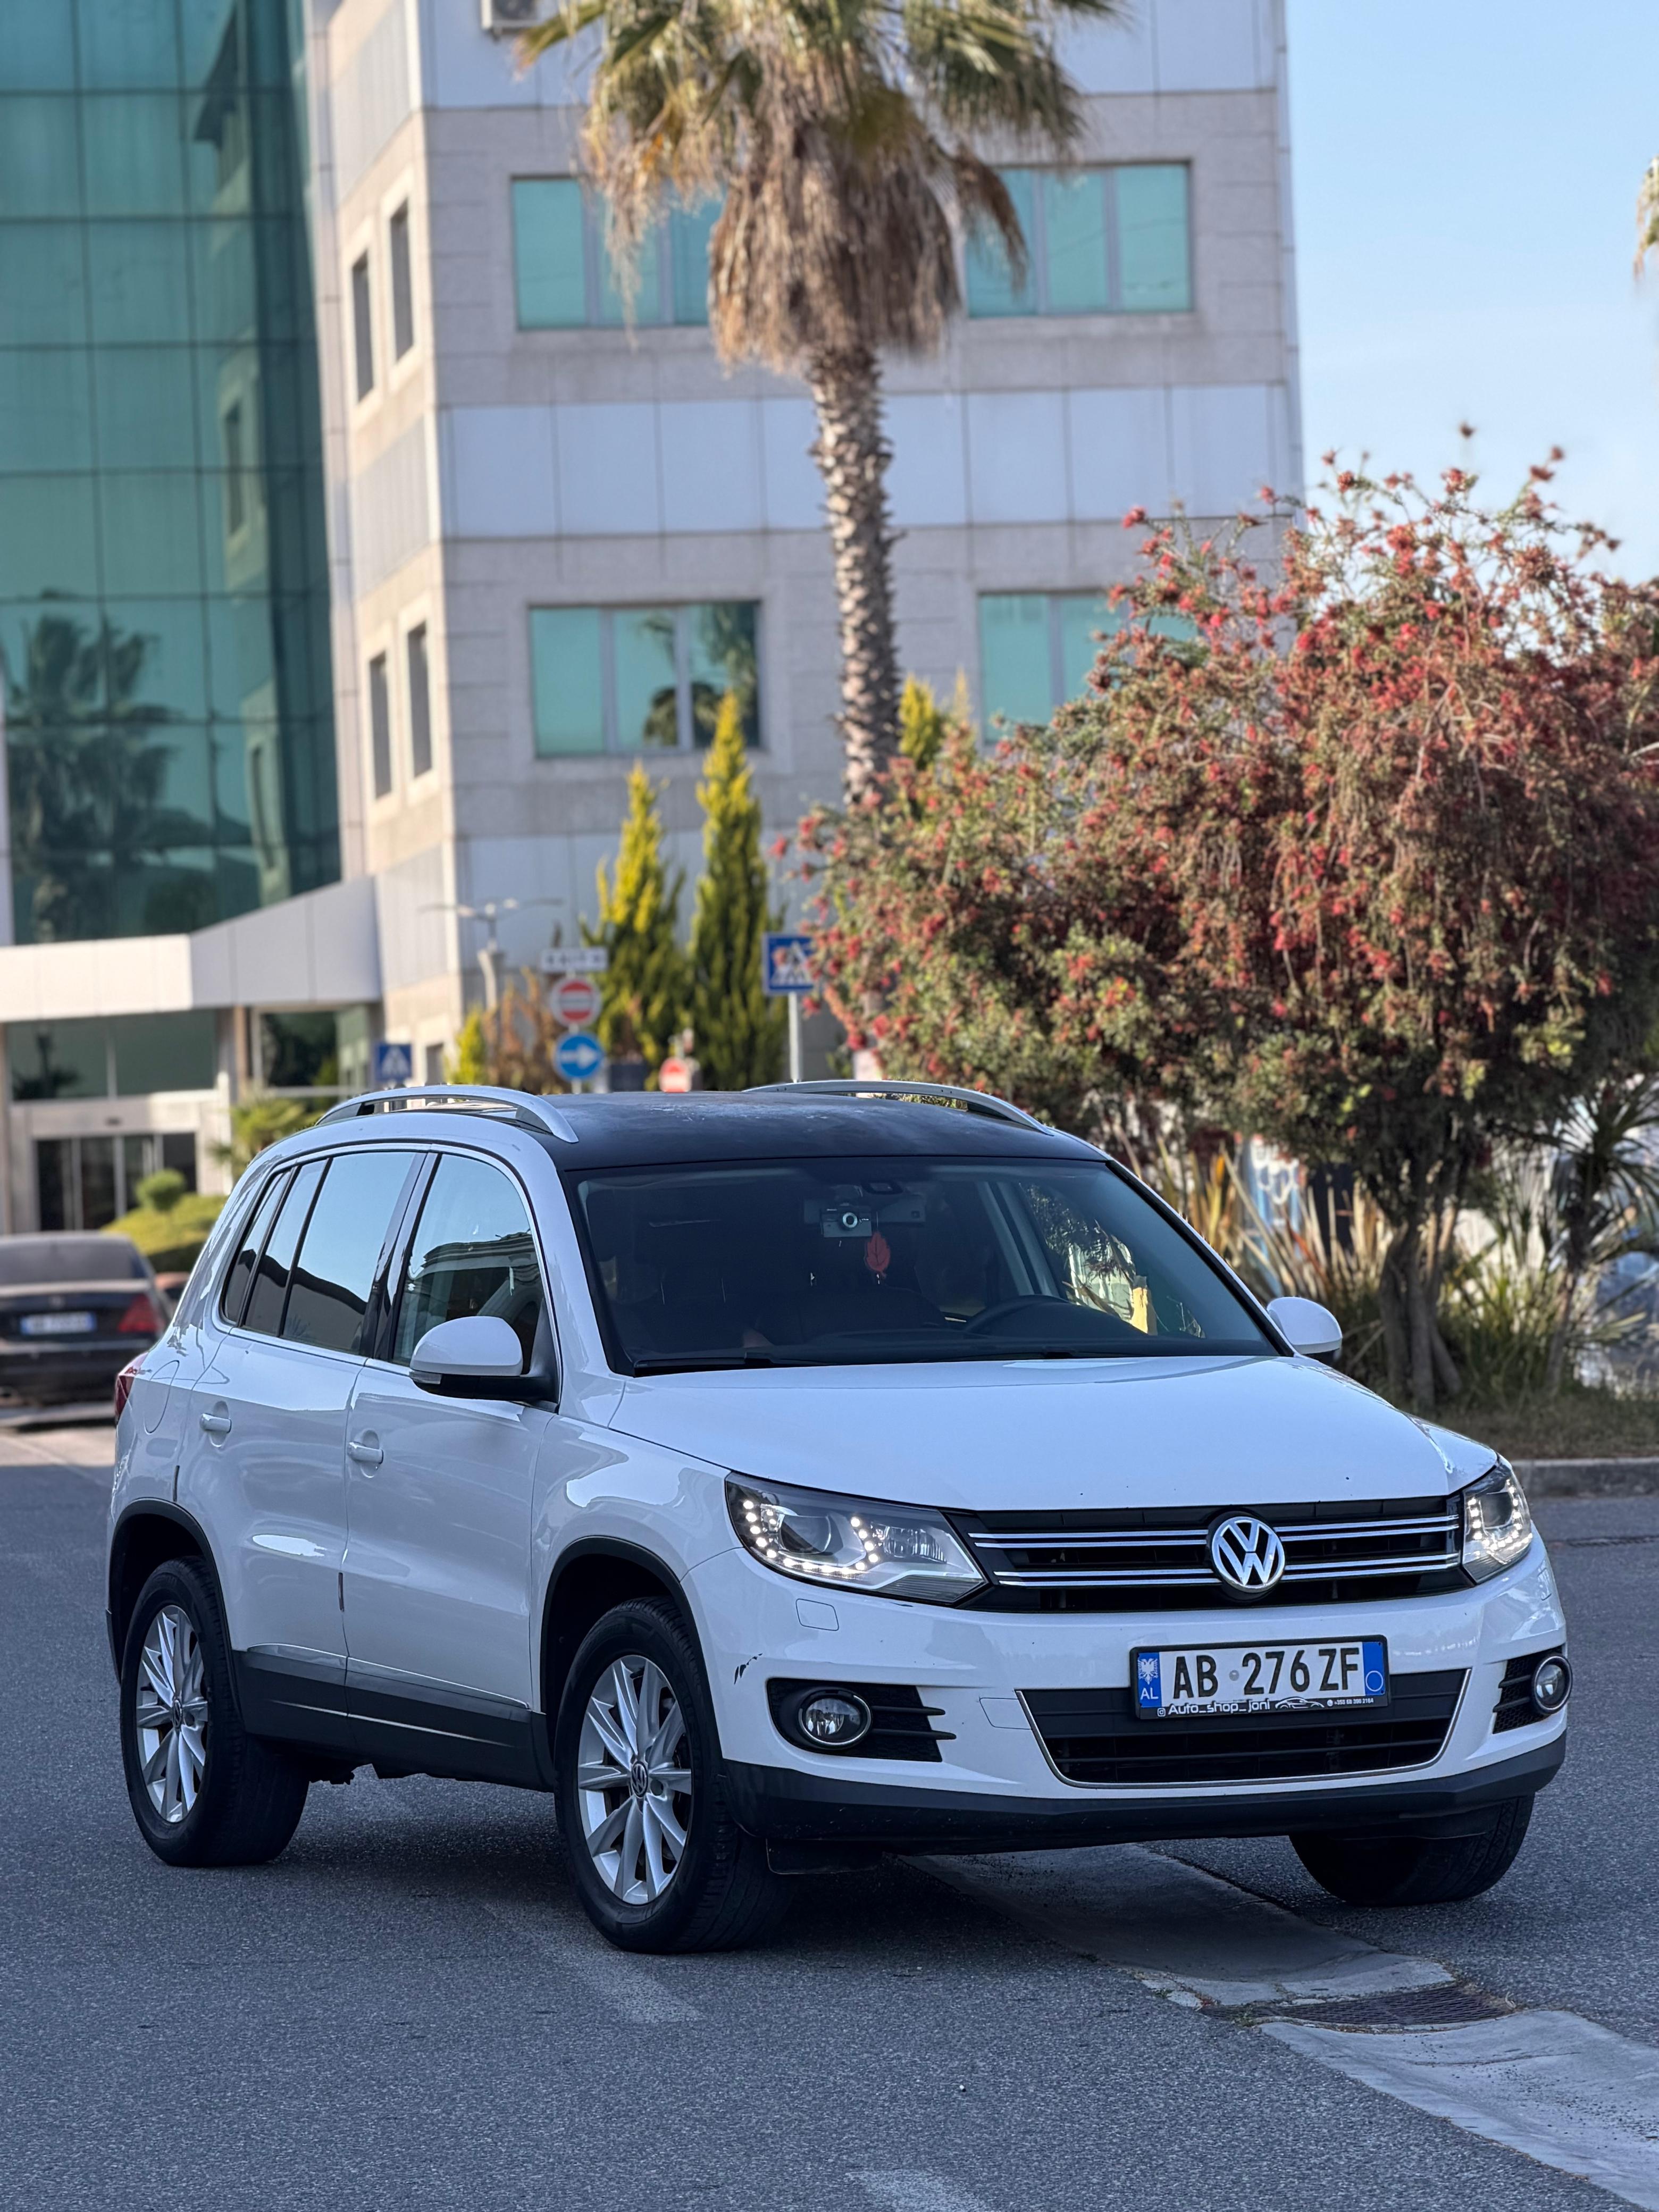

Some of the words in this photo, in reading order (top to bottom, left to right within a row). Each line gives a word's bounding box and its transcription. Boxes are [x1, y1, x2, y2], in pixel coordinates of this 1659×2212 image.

[1212, 1516, 1285, 1588] VW
[1140, 1687, 1159, 1700] AL
[1173, 1655, 1218, 1698] AB
[1242, 1649, 1310, 1695] 276
[1318, 1647, 1360, 1691] ZF
